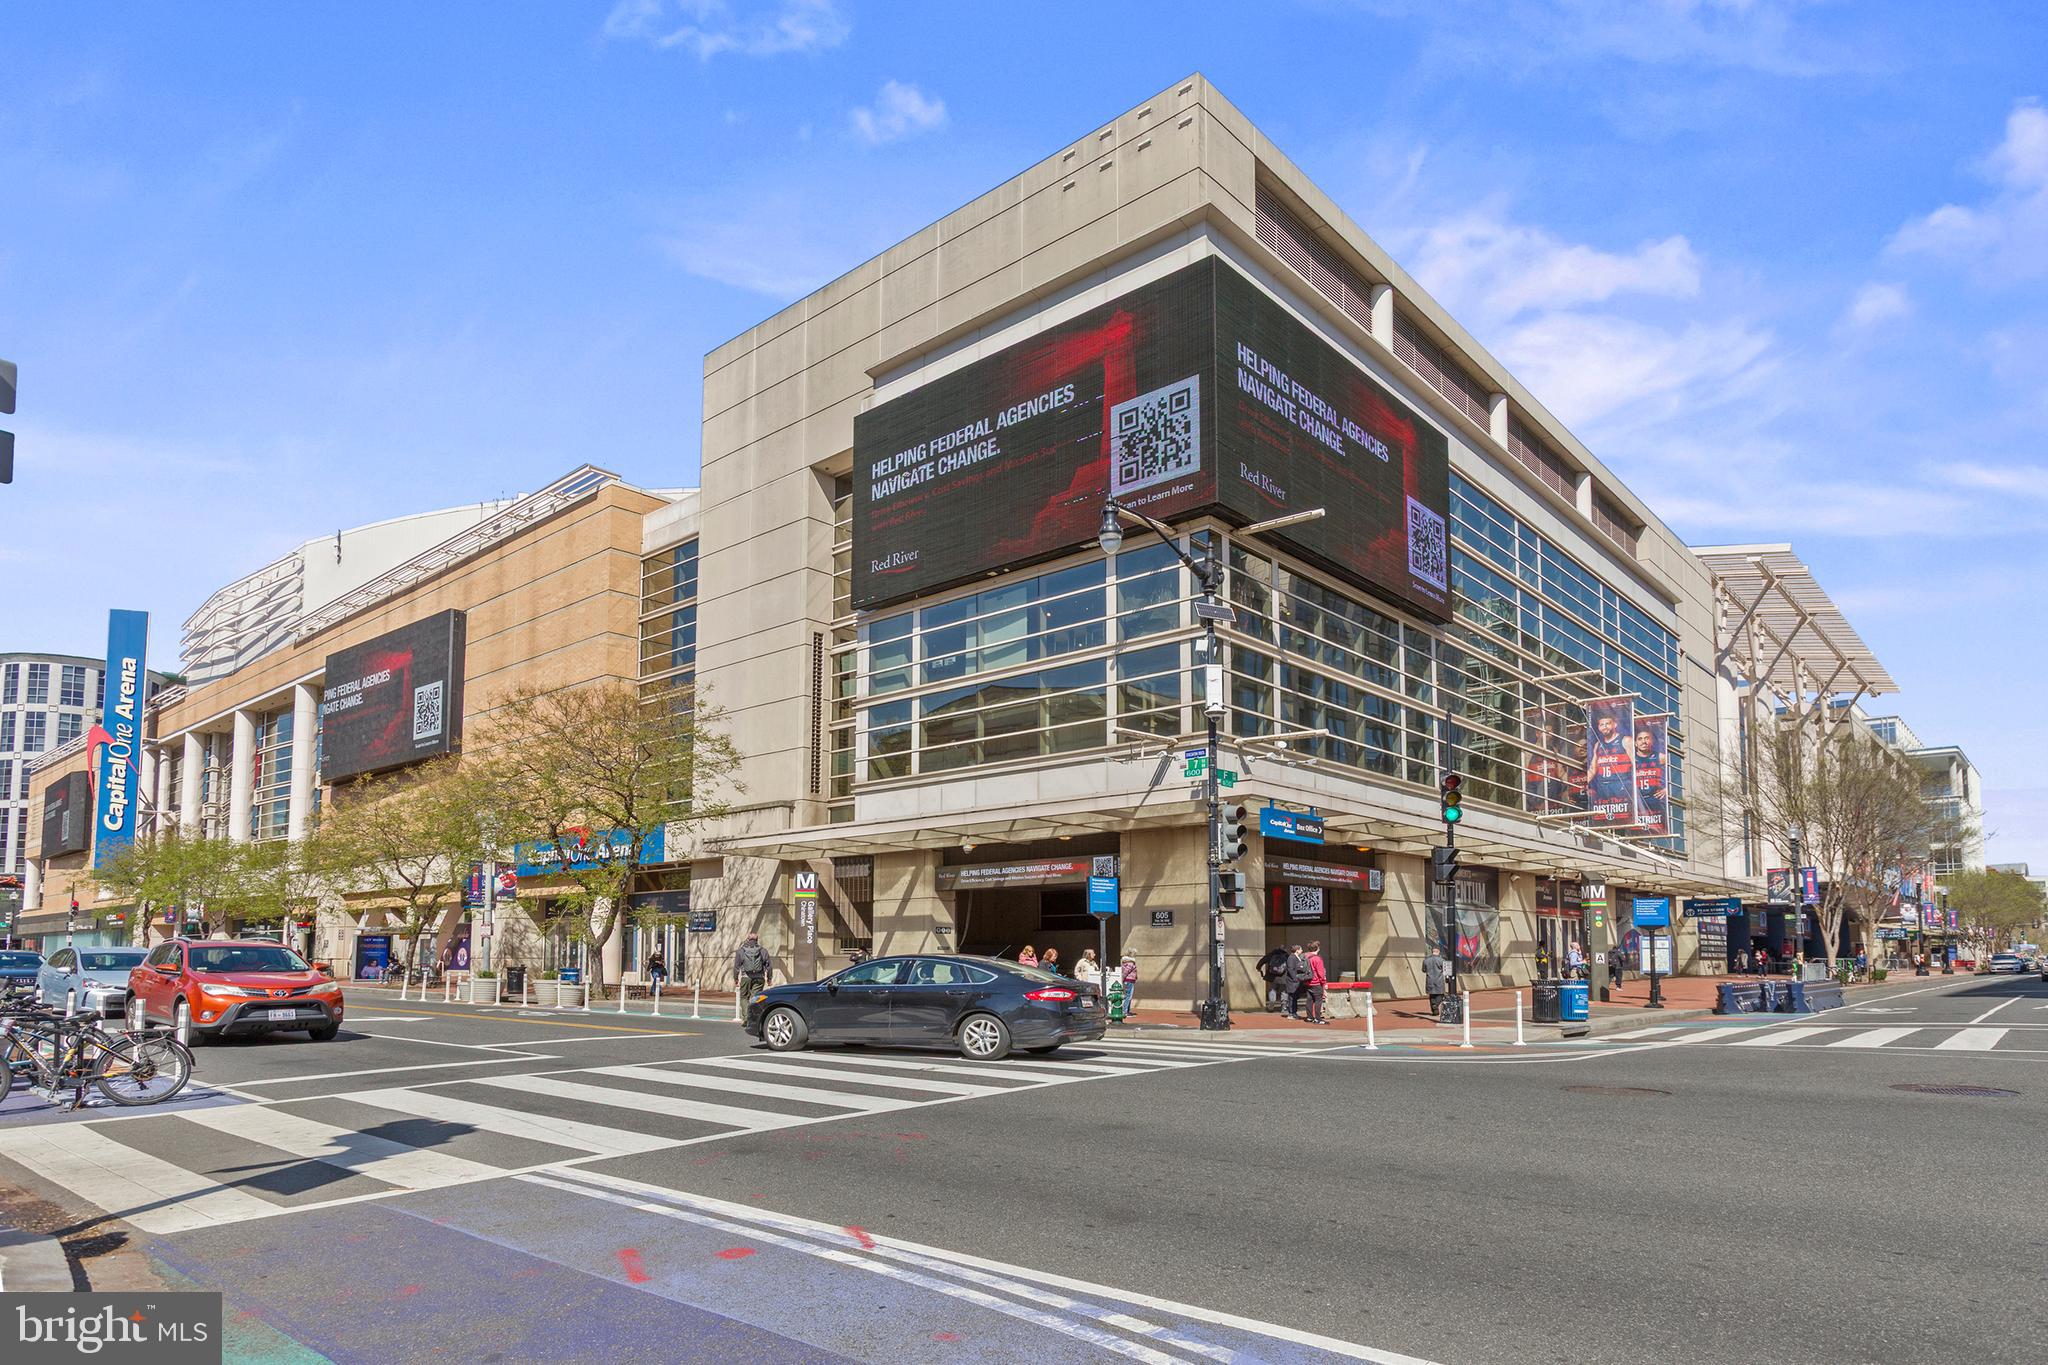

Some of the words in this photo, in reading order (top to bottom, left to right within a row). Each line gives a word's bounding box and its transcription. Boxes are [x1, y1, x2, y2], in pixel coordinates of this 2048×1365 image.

[1237, 341, 1289, 395] HELPING
[1292, 380, 1340, 429] FEDERAL
[1342, 417, 1389, 463] AGENCIES
[1237, 368, 1296, 424] NAVIGATE
[1299, 410, 1345, 457] CHANGE.
[871, 444, 926, 480] HELPING
[930, 419, 993, 458] FEDERAL
[996, 383, 1075, 431] AGENCIES
[871, 462, 935, 501] NAVIGATE
[938, 437, 1001, 476] CHANGE.
[1240, 462, 1259, 486] Red
[1262, 475, 1287, 501] River
[1120, 501, 1136, 510] can
[1138, 497, 1146, 506] to
[1148, 490, 1170, 503] Learn
[1172, 482, 1194, 496] More
[871, 555, 890, 573] Red
[892, 550, 919, 566] River
[115, 656, 137, 720] Arena
[324, 686, 336, 702] PING
[336, 680, 362, 697] FEDERAL
[362, 669, 390, 690] AGENCIES
[1194, 760, 1198, 769] 7
[1602, 766, 1612, 778] 16
[1640, 780, 1650, 790] 15
[1594, 802, 1628, 813] DISTRICT
[797, 874, 815, 889] M
[1314, 866, 1329, 874] AGENCIES
[1432, 880, 1486, 904] MOENTUM
[1581, 886, 1590, 899] M
[1591, 885, 1605, 898] M
[806, 901, 815, 925] Gallery
